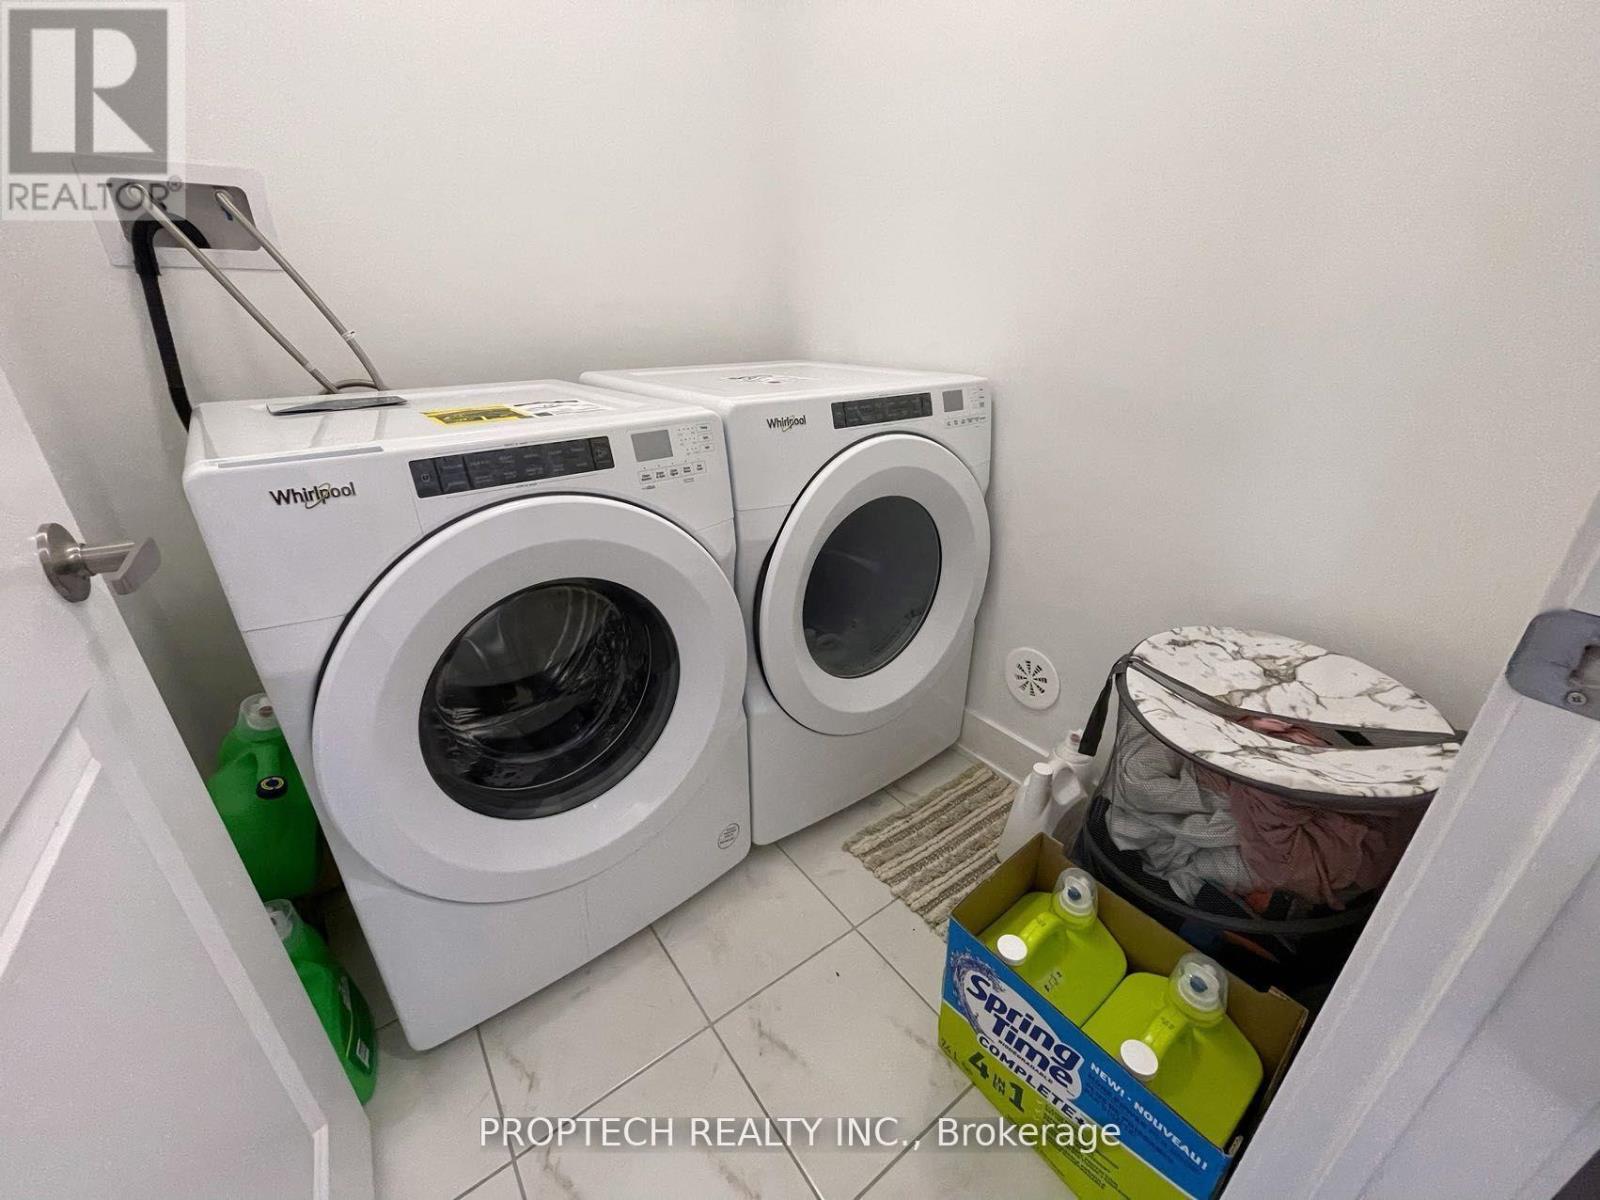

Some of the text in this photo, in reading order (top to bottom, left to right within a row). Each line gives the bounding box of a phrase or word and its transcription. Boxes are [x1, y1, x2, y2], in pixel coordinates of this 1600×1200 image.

[767, 414, 807, 431] Whirlpool
[269, 481, 356, 507] Whirlpool
[966, 974, 1081, 1071] Spring
[992, 1013, 1074, 1089] Time
[968, 1051, 989, 1080] 4
[1009, 1082, 1025, 1114] 1
[1090, 1062, 1125, 1098] NEW!
